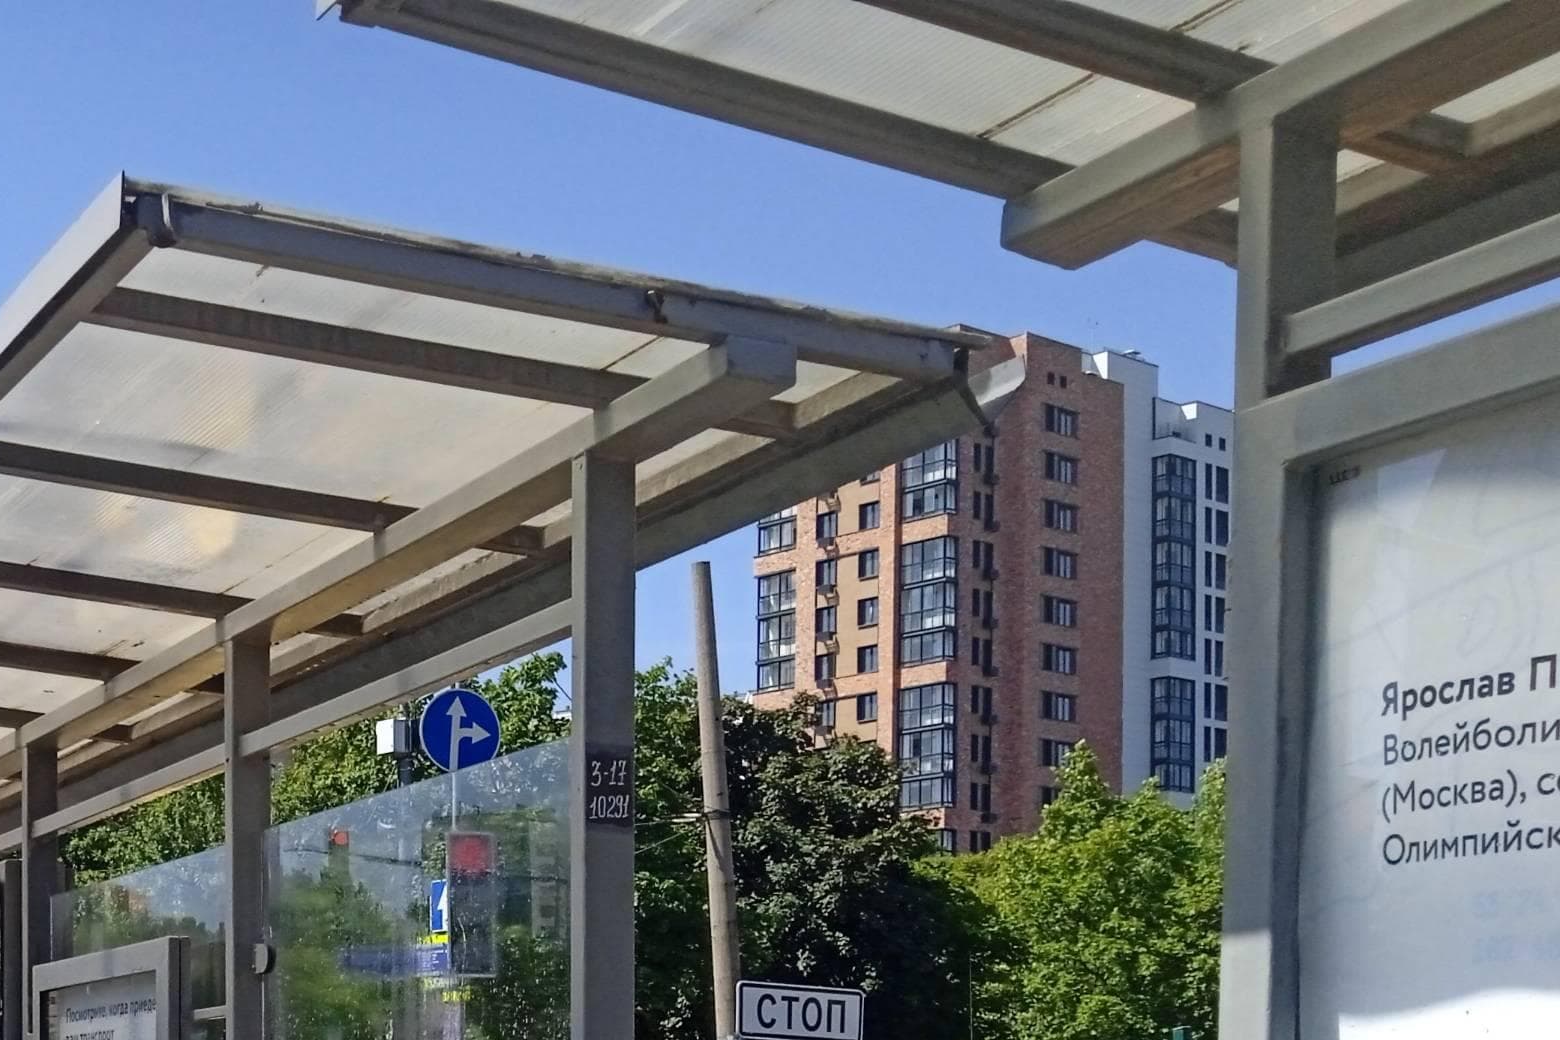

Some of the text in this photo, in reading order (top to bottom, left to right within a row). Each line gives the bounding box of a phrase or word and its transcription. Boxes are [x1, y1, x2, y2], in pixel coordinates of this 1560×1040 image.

[1380, 671, 1516, 721] Ярослав
[590, 760, 627, 787] 3-17
[589, 794, 630, 819] 10291
[1382, 768, 1560, 824] (Москва), с
[757, 993, 846, 1034] СТОП
